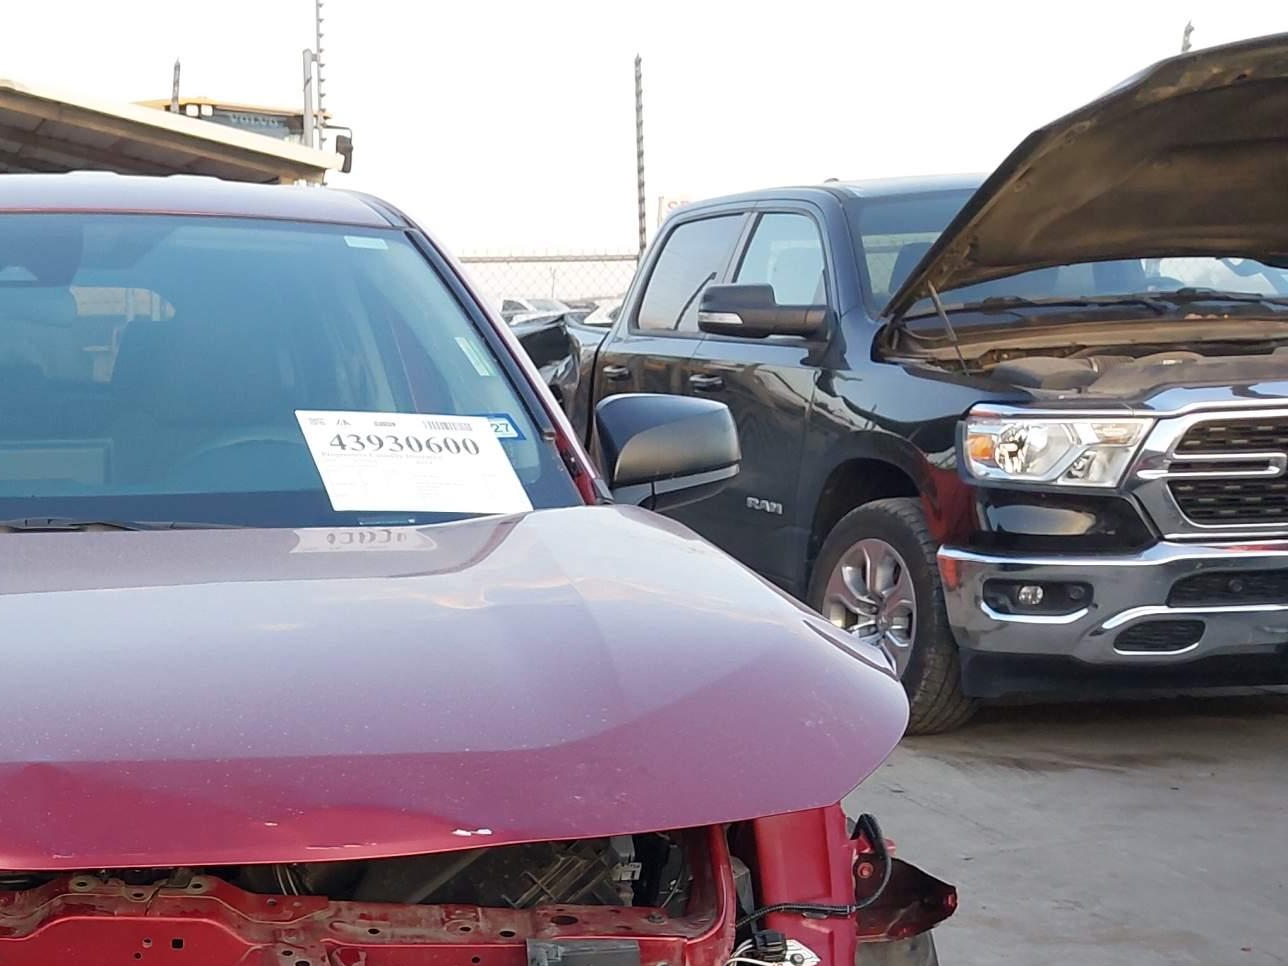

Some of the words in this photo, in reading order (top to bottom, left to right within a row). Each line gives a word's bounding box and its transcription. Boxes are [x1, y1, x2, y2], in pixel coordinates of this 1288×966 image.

[229, 114, 280, 127] VOLVO
[491, 423, 511, 434] 27
[329, 432, 480, 456] 43930600
[746, 496, 783, 514] RAM
